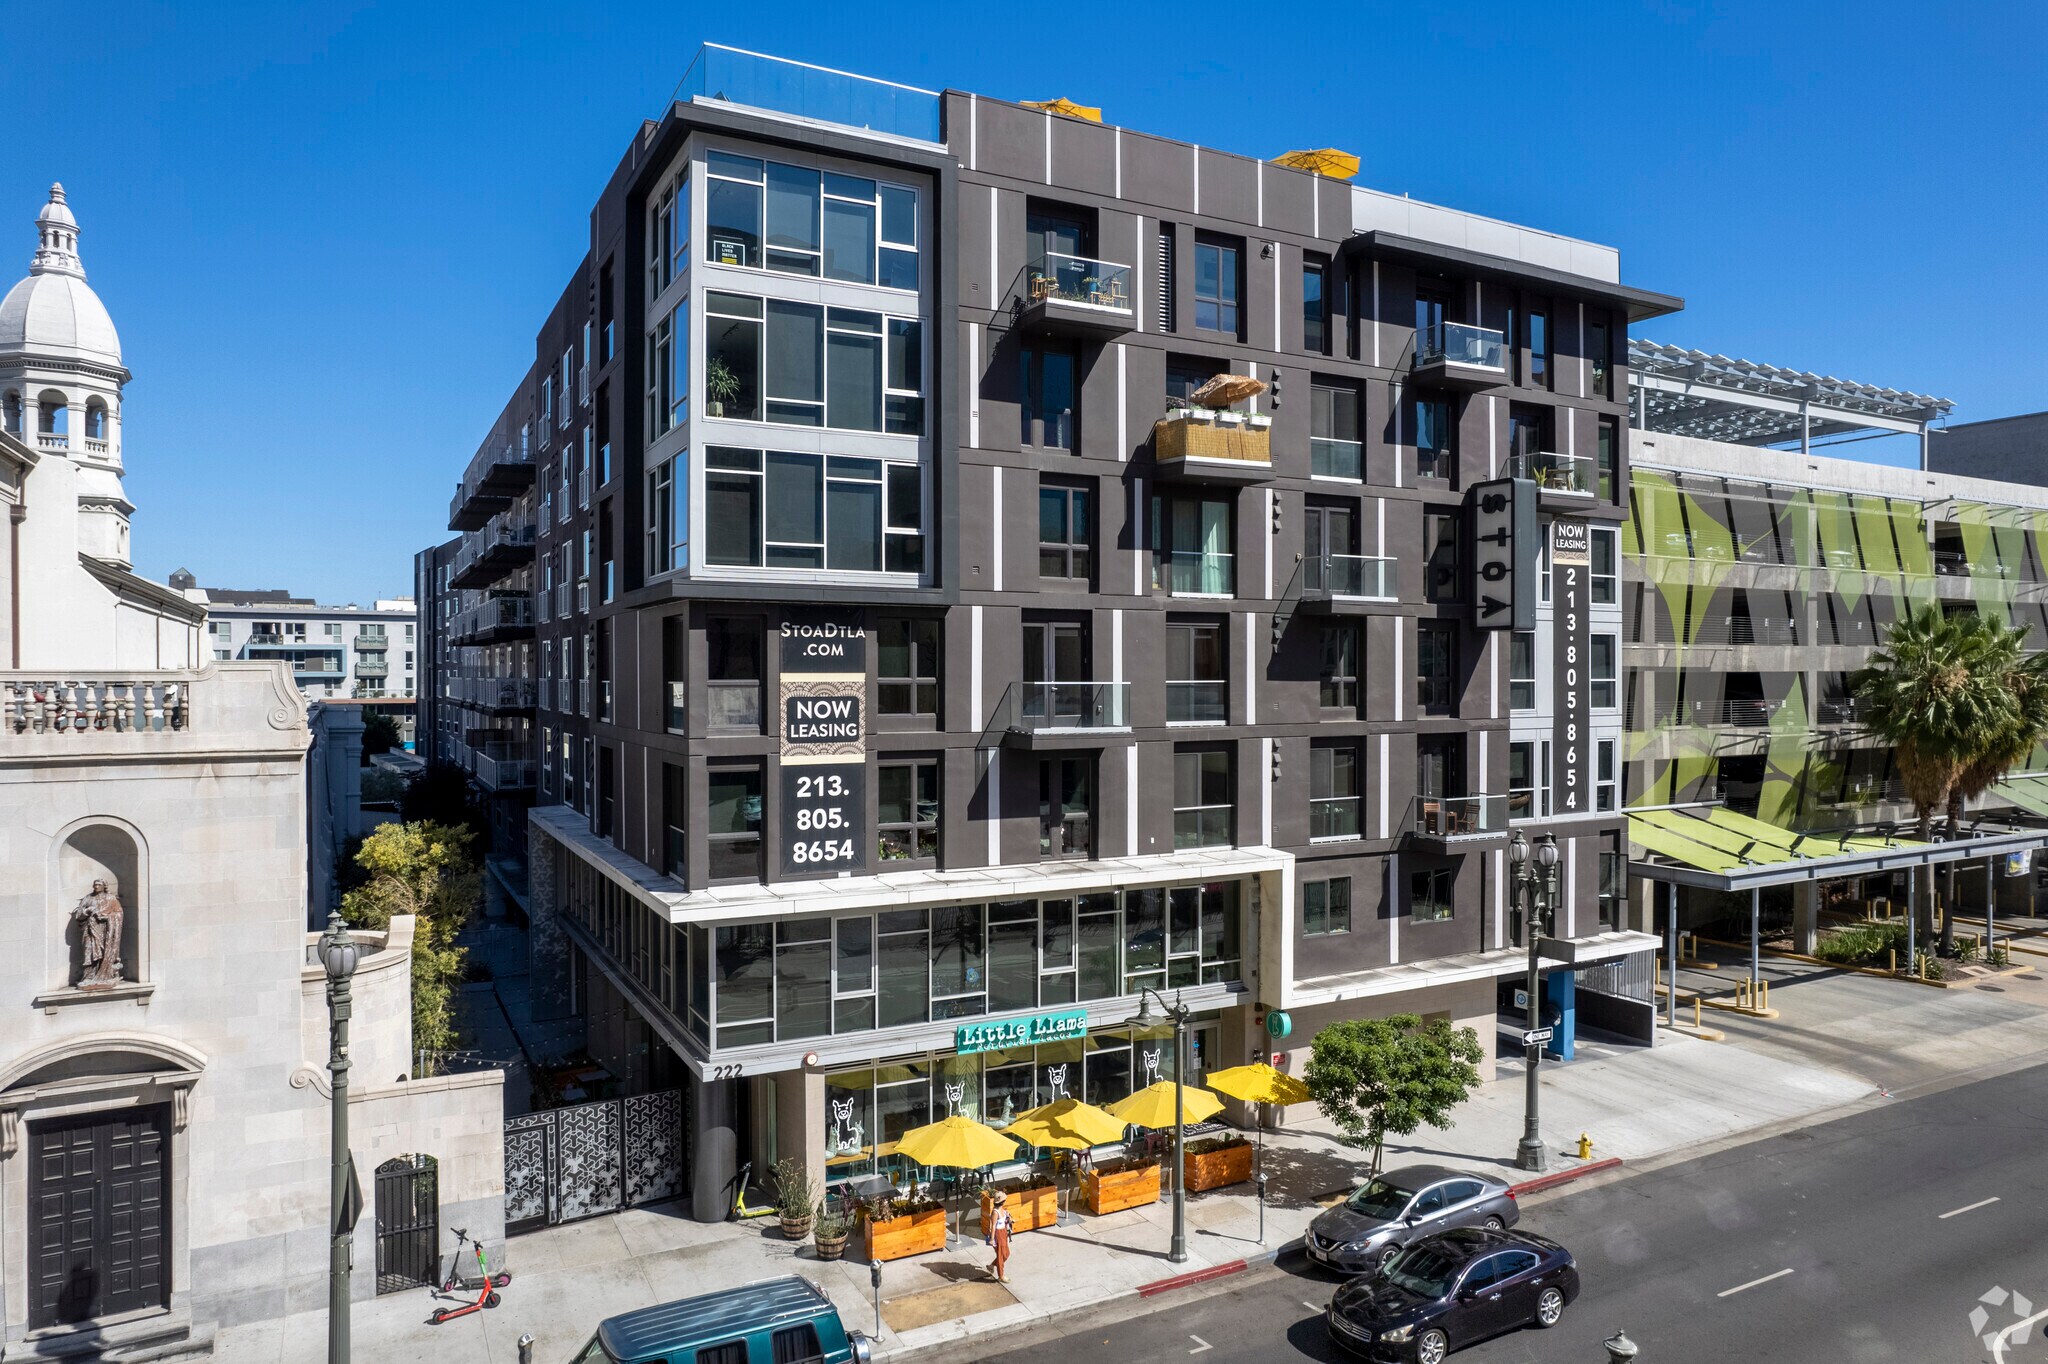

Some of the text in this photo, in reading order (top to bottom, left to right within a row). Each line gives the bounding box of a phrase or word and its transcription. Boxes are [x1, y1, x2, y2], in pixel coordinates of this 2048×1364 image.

[1558, 525, 1583, 537] NOW
[1556, 539, 1587, 550] LEASING
[1482, 493, 1507, 619] STOA
[803, 643, 844, 656] .COM
[797, 700, 852, 719] NOW
[790, 723, 857, 738] LEASING
[796, 775, 850, 798] 213.
[796, 807, 850, 830] 805.
[793, 839, 854, 863] 8654
[962, 1016, 1087, 1045] Little Llama
[714, 1063, 743, 1080] 222
